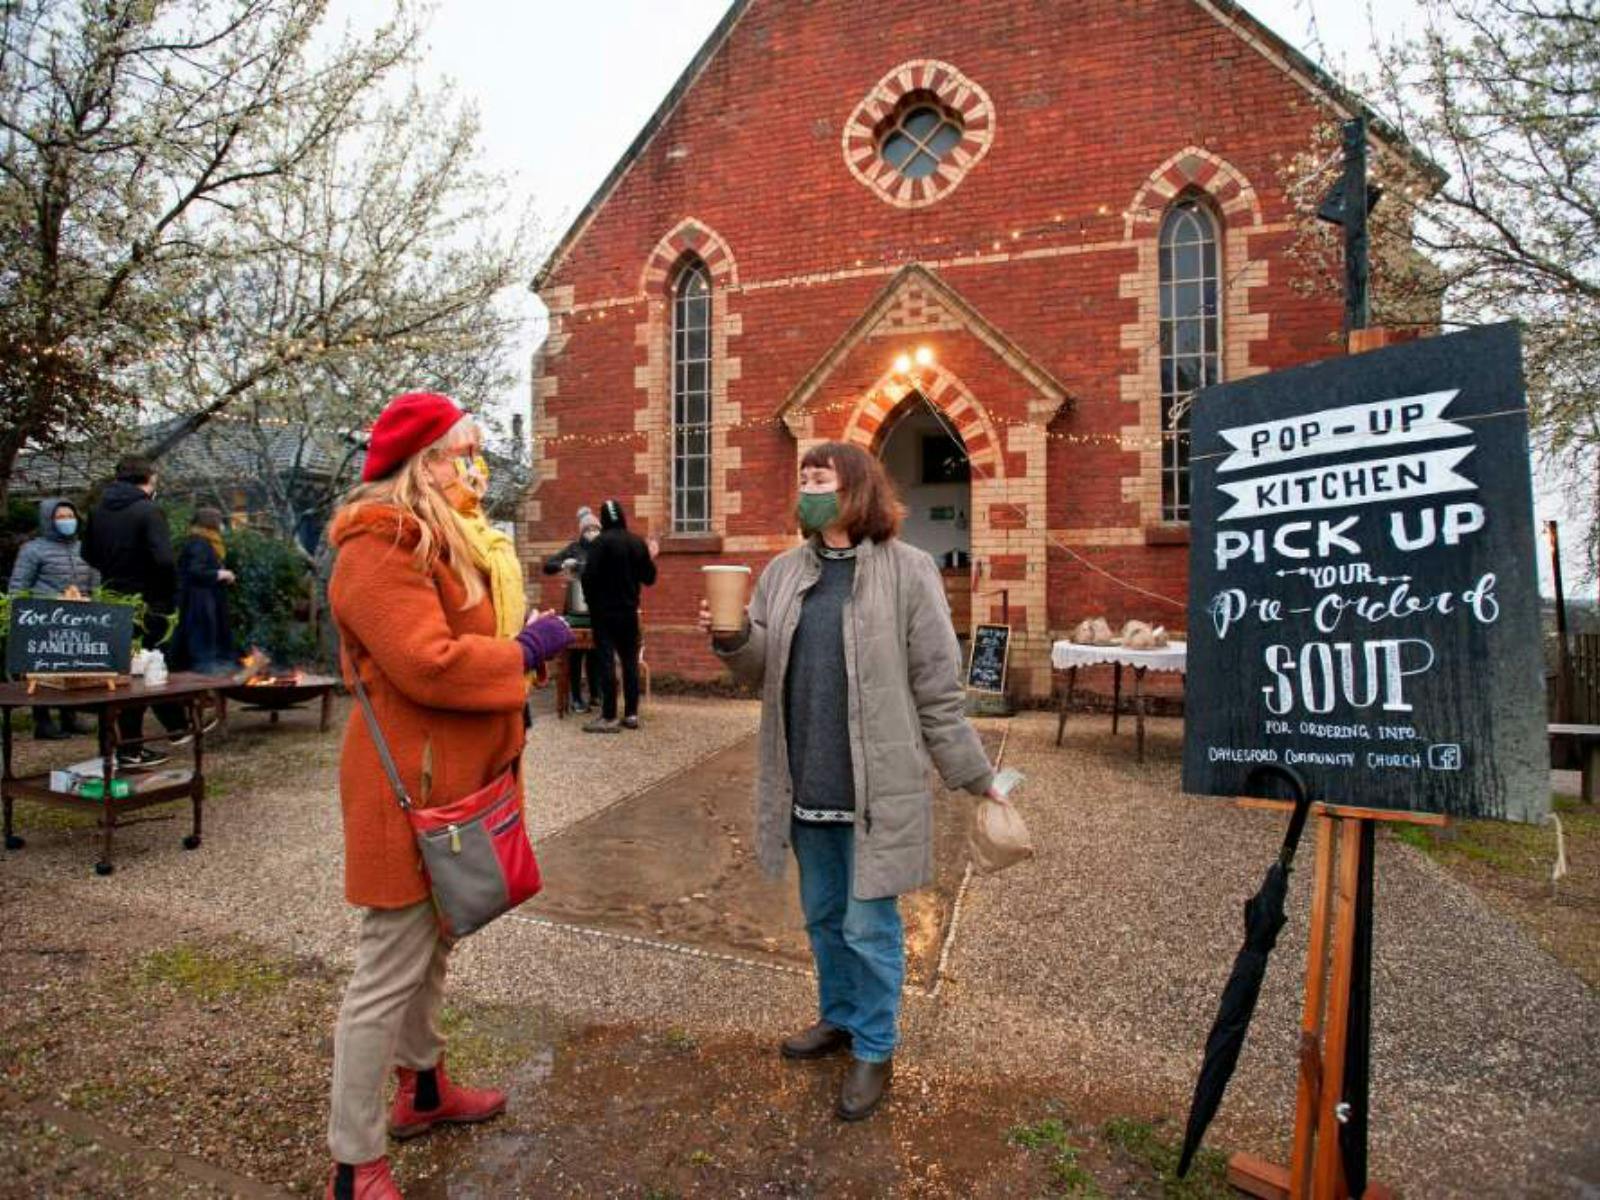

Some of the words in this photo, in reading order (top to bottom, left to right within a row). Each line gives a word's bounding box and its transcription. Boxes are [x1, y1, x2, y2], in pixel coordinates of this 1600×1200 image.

[1251, 403, 1424, 457] POP-UP
[1256, 461, 1427, 508] KITCHEN
[1214, 516, 1362, 570] PICK
[1390, 502, 1485, 551] UP
[1309, 563, 1374, 588] YOUR
[18, 607, 111, 626] Welcome
[1262, 638, 1435, 715] SOUP
[1265, 720, 1293, 735] FOR
[1299, 721, 1371, 740] ORDERING
[1208, 746, 1278, 763] DAYLESFORD
